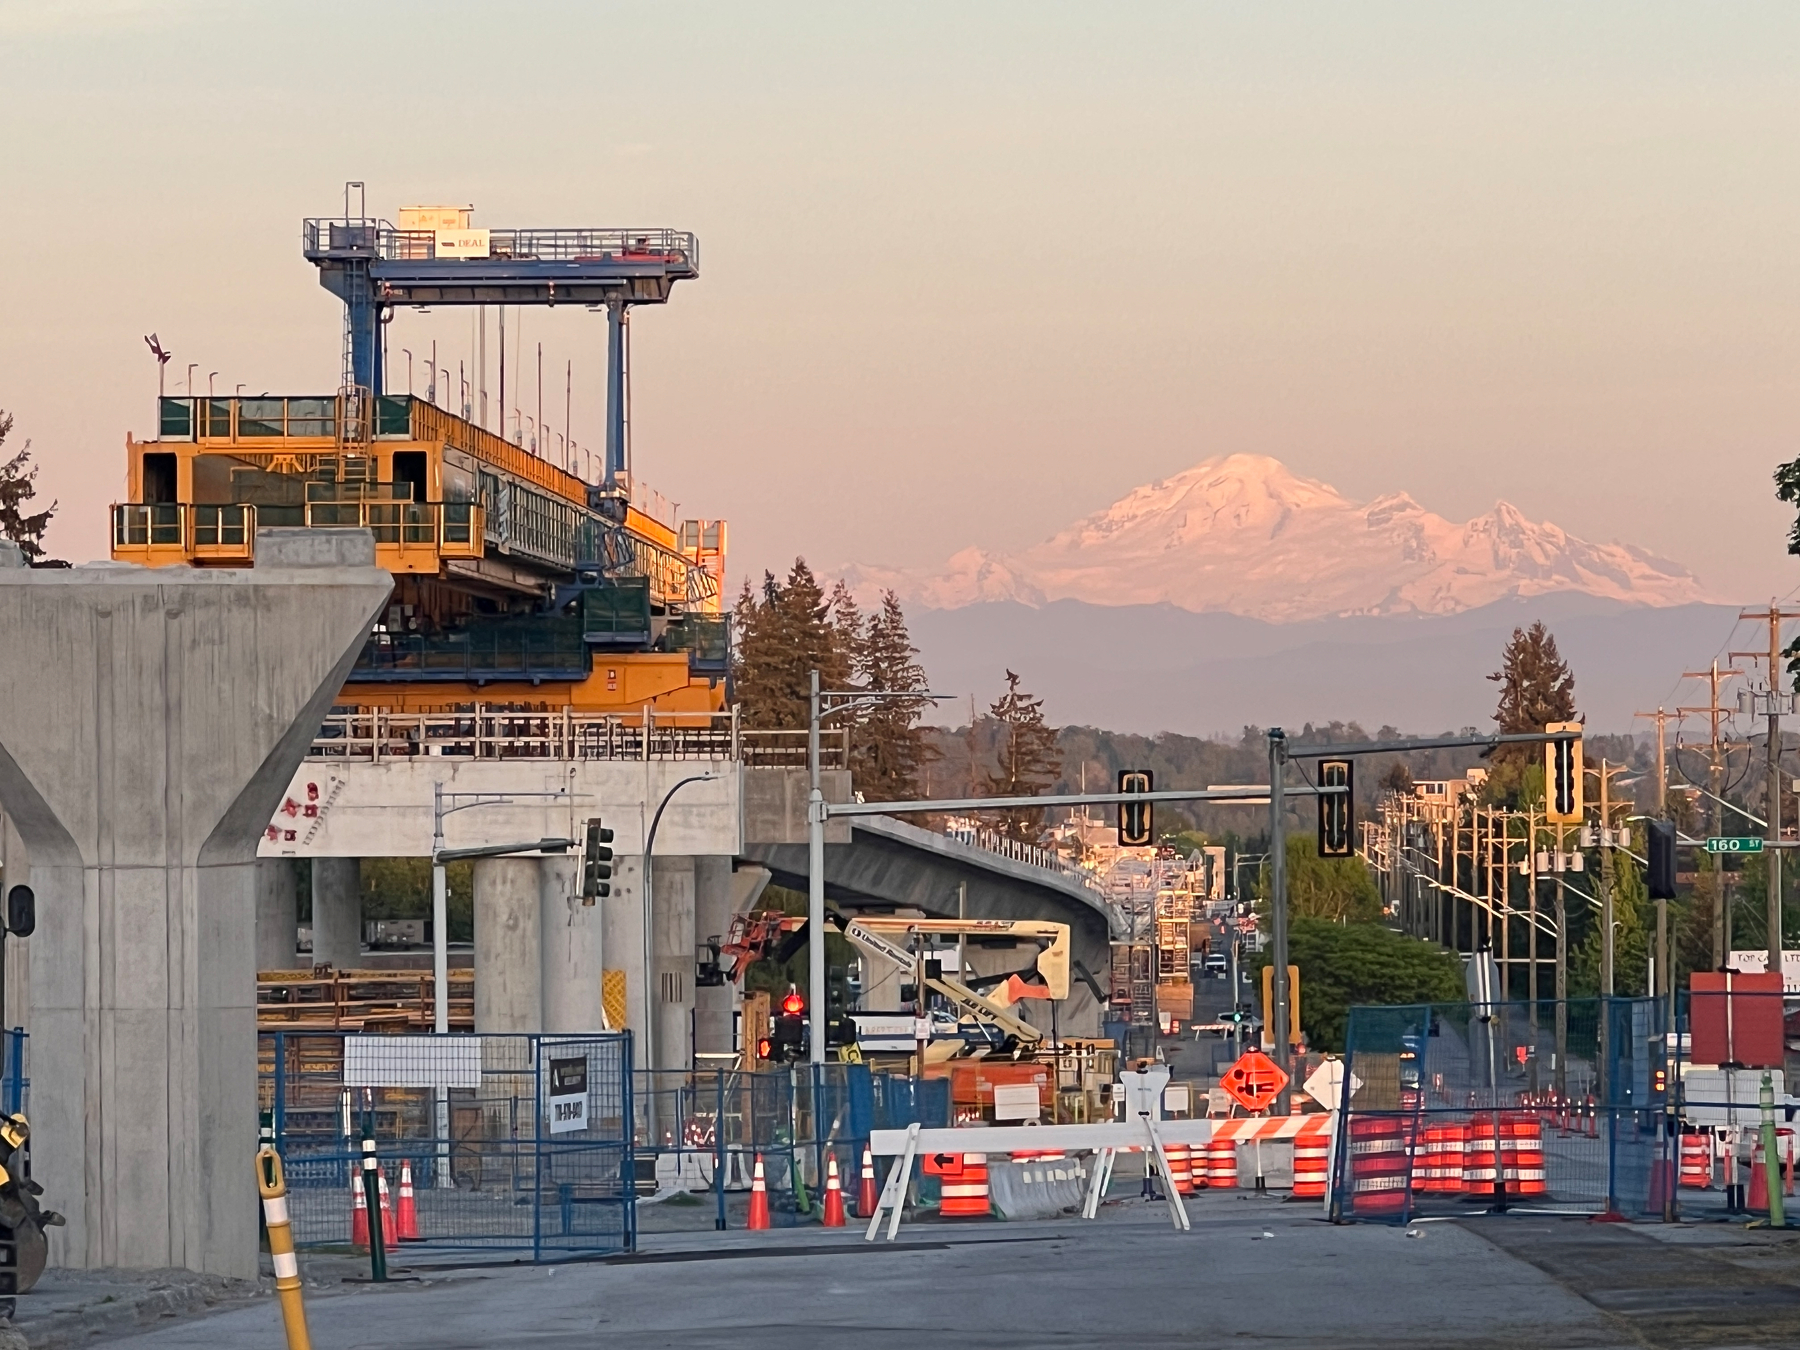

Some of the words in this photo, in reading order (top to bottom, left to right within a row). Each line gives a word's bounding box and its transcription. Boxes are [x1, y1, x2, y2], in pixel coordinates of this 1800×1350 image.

[458, 239, 485, 248] DEAL
[1711, 839, 1740, 851] 160
[1748, 839, 1760, 848] ST
